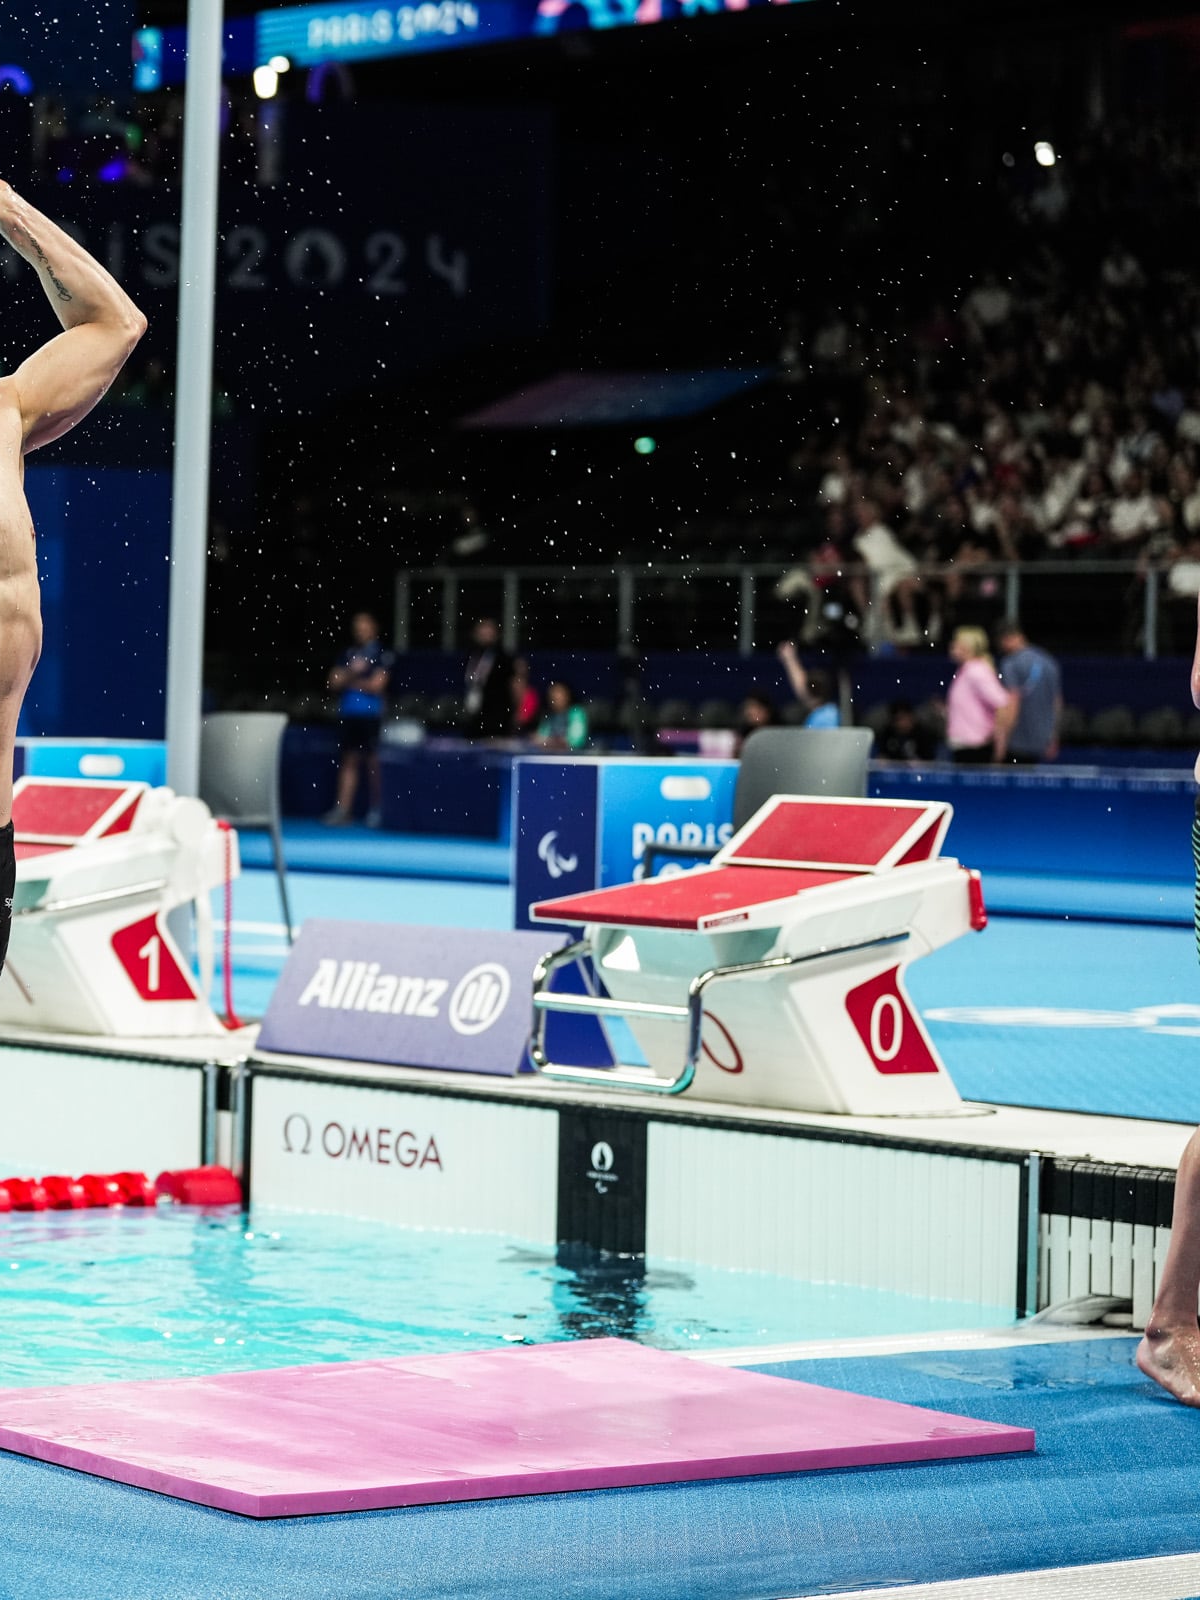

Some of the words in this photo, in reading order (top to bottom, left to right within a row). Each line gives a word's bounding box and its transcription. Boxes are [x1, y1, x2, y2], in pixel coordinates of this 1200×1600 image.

[226, 226, 469, 297] 2024
[138, 936, 160, 992] 1
[298, 959, 450, 1018] Allianz
[870, 994, 903, 1062] 0
[322, 1121, 445, 1172] OMEGA
